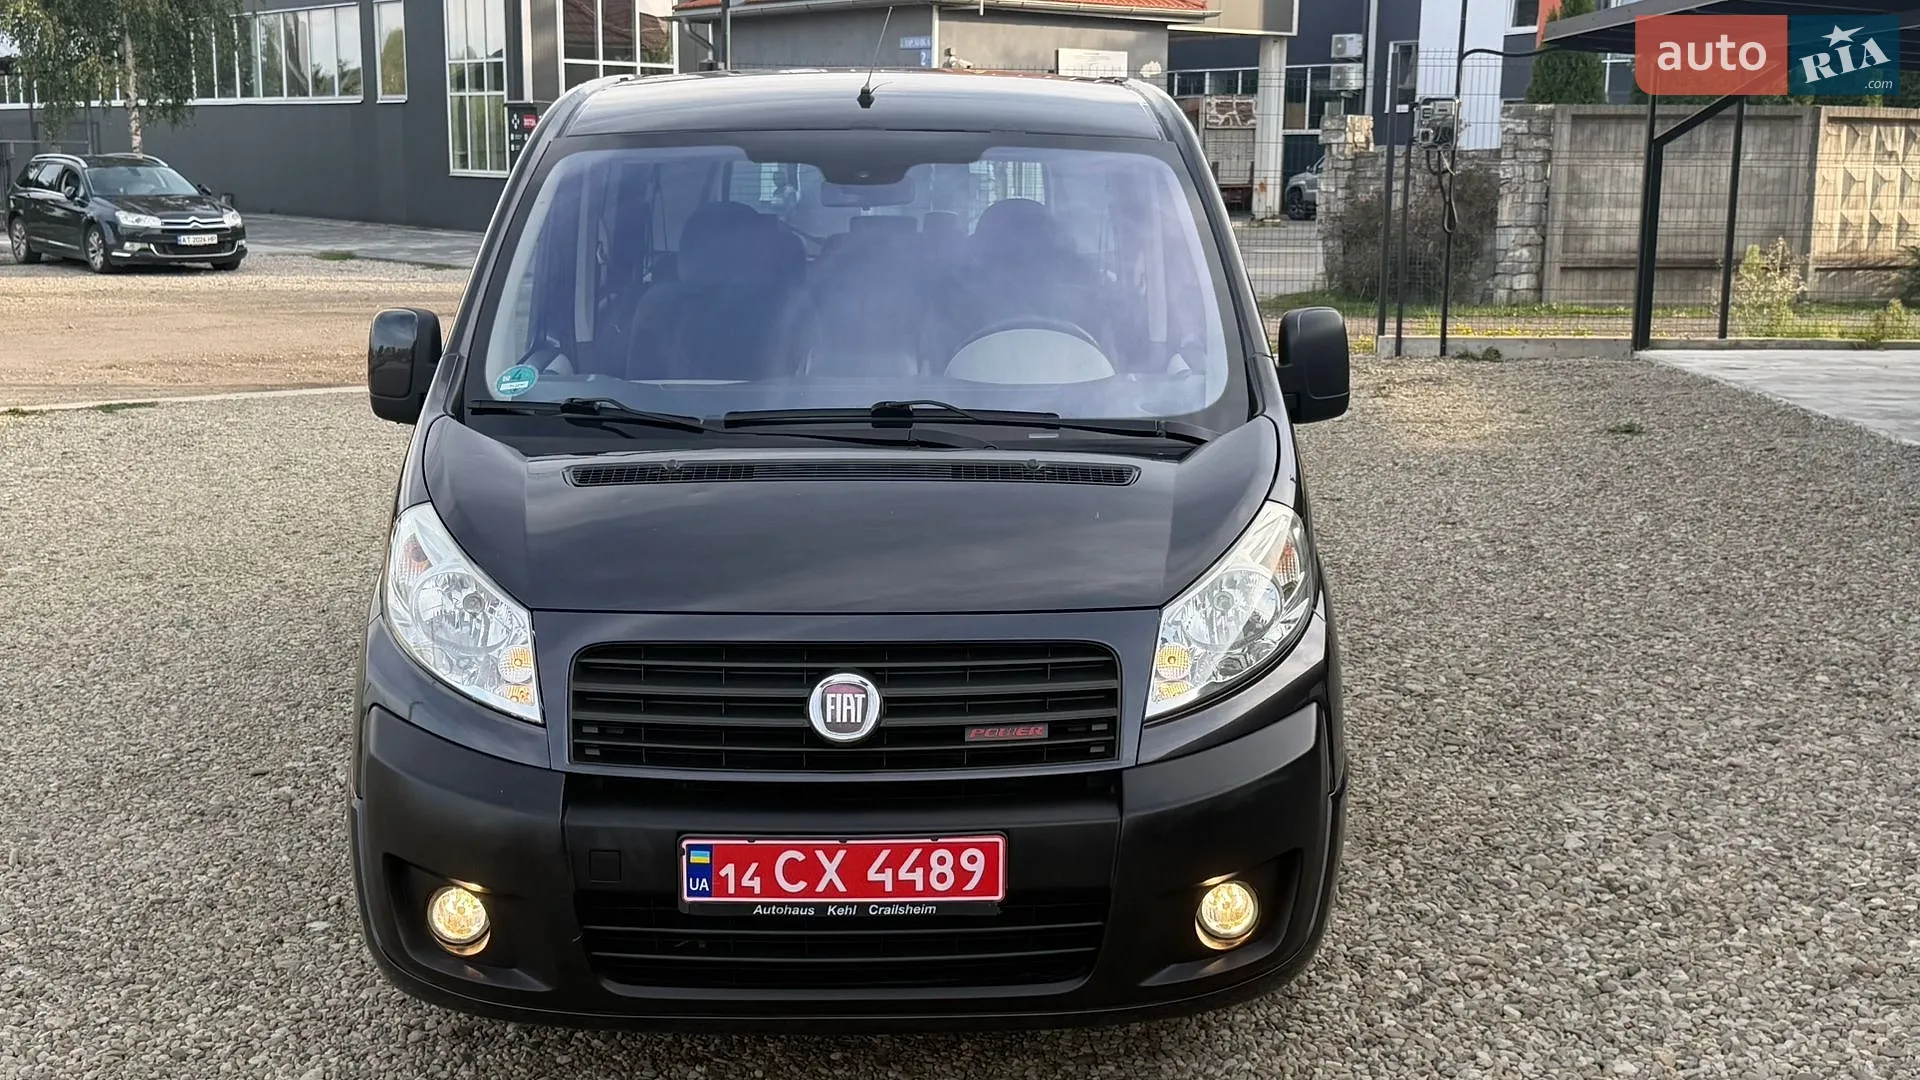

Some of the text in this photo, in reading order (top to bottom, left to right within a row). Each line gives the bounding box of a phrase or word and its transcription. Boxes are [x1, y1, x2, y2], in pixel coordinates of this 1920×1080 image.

[826, 693, 866, 723] FIAT
[969, 725, 1045, 738] POWER
[718, 848, 986, 894] 14 CX 4489
[689, 878, 709, 891] UA
[753, 904, 937, 916] Autohaus Kehl Crailsheim
